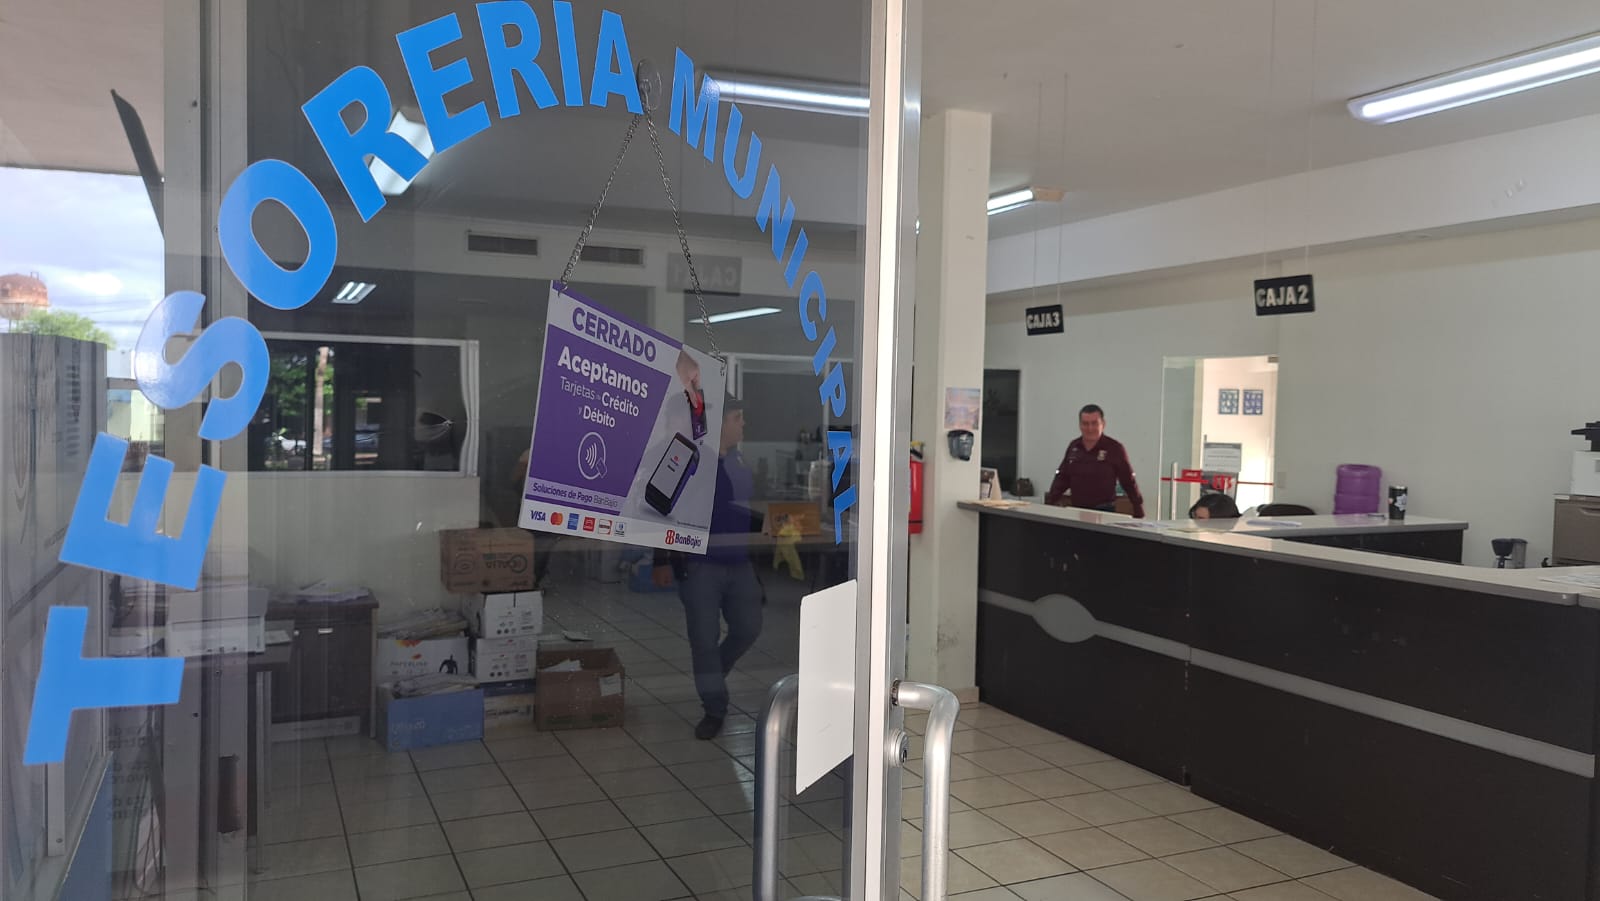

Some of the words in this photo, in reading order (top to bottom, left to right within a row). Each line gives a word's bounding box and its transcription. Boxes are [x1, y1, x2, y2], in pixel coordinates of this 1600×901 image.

[1255, 285, 1309, 308] CAJA2
[1026, 310, 1061, 330] CAJA3
[572, 306, 657, 362] CERRADO
[24, 0, 645, 764] TESORERIA
[669, 48, 858, 545] MUNICIPAL
[557, 345, 649, 399] Aceptamos
[560, 376, 596, 400] Tarjetas
[601, 391, 640, 417] Crédito
[583, 405, 616, 428] Débito
[533, 482, 568, 498] Soluciones
[567, 489, 577, 499] de
[577, 491, 593, 503] Pago
[531, 510, 546, 522] VISA
